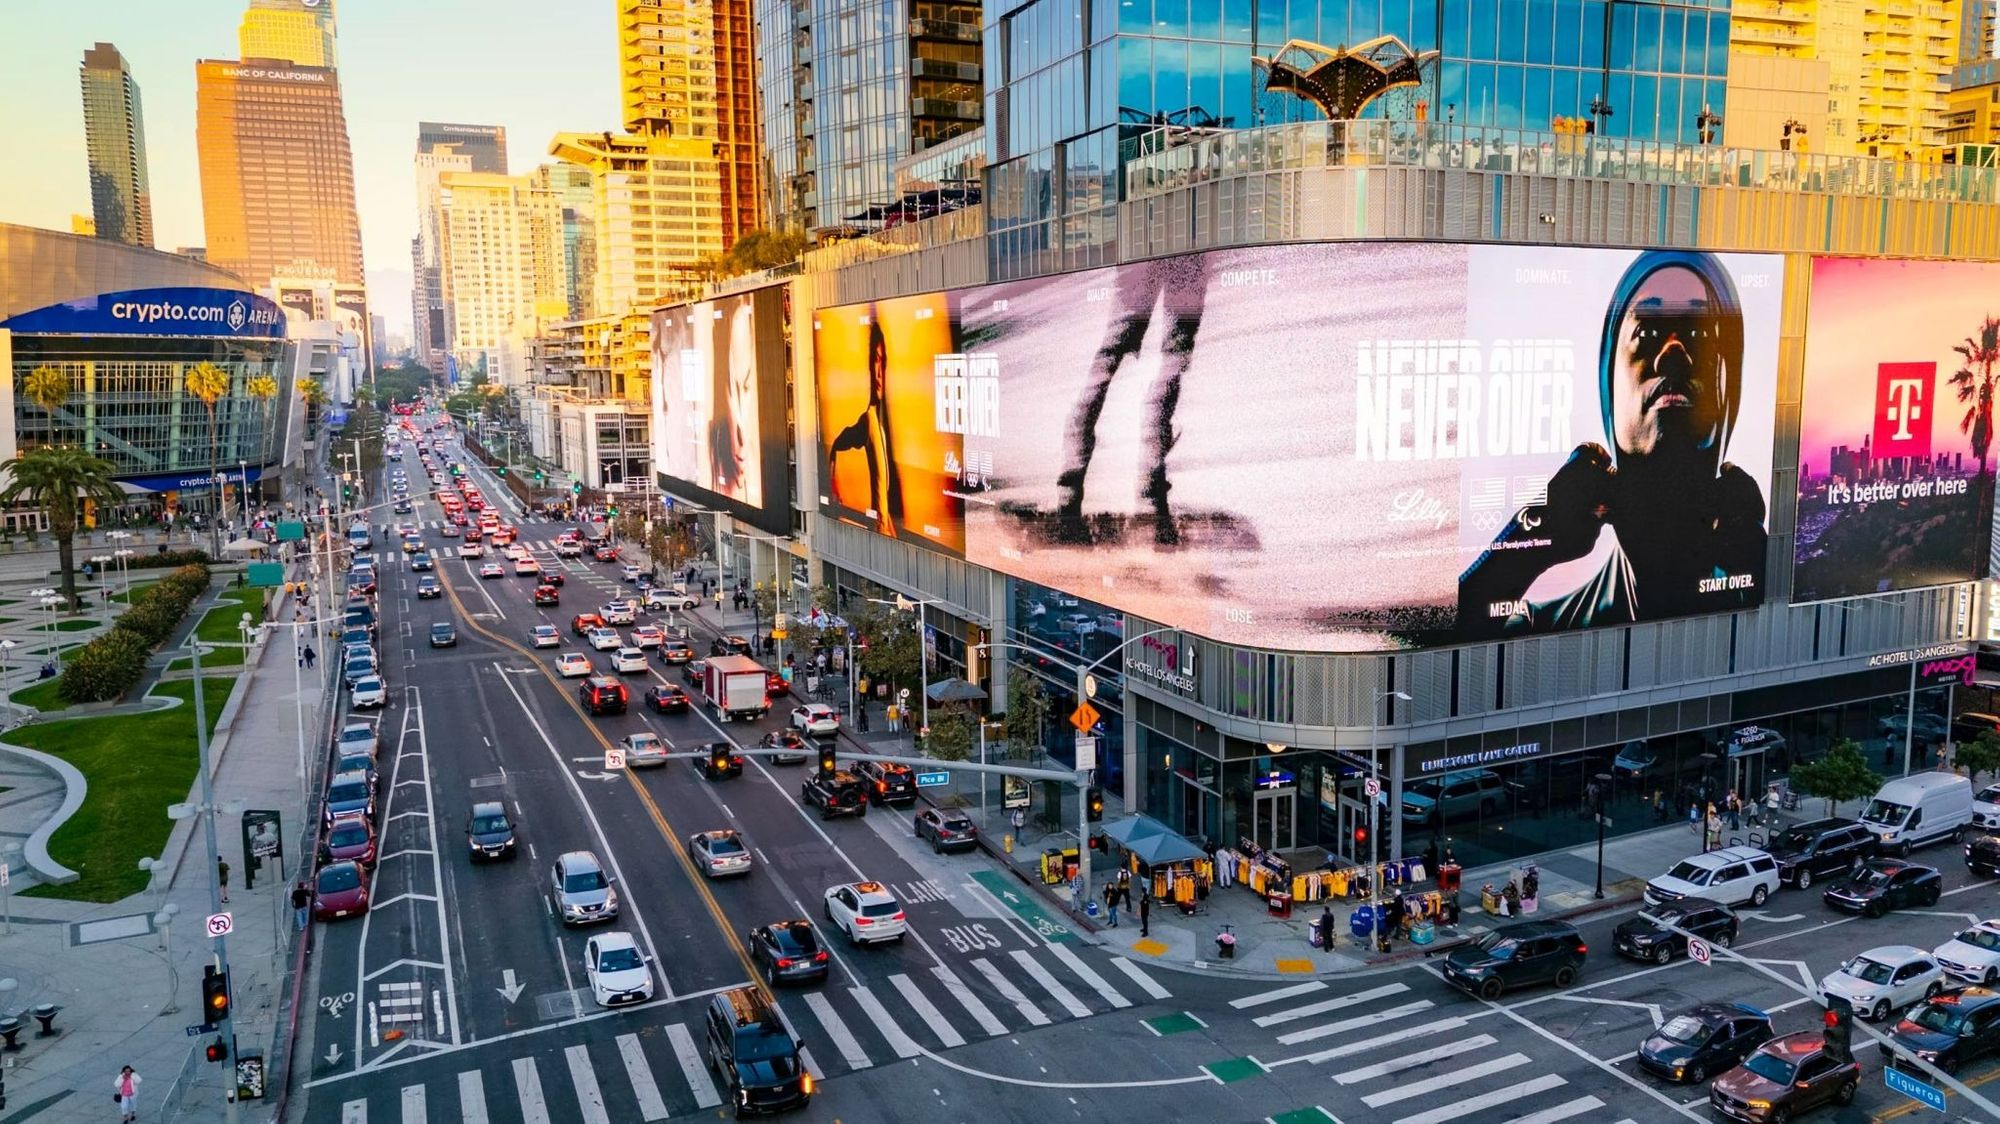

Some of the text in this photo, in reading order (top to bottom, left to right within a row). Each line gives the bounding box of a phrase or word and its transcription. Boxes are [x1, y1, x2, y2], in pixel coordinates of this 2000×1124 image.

[222, 67, 325, 82] BANC OF CALIFORNIA
[112, 301, 278, 325] crypto.com ARENA
[1355, 339, 1575, 461] NEVER OVER
[1828, 477, 1967, 504] It's better over here
[1387, 488, 1450, 530] Lilly
[1503, 540, 1533, 549] Paralympic
[1534, 538, 1552, 547] Teams
[1699, 574, 1754, 592] START OVER.
[1226, 608, 1257, 624] LOSE.
[1869, 655, 1882, 666] AC
[1883, 650, 1908, 664] HOTEL
[1925, 644, 1958, 658] ANGELES
[1134, 660, 1153, 676] HOTEL
[1154, 667, 1166, 681] LOS
[1166, 672, 1193, 692] ANGELES
[1743, 725, 1758, 736] 1260
[920, 776, 935, 785] Pico
[891, 878, 956, 905] LANE
[940, 923, 1002, 954] BUS
[1889, 1072, 1941, 1104] Figueroa
